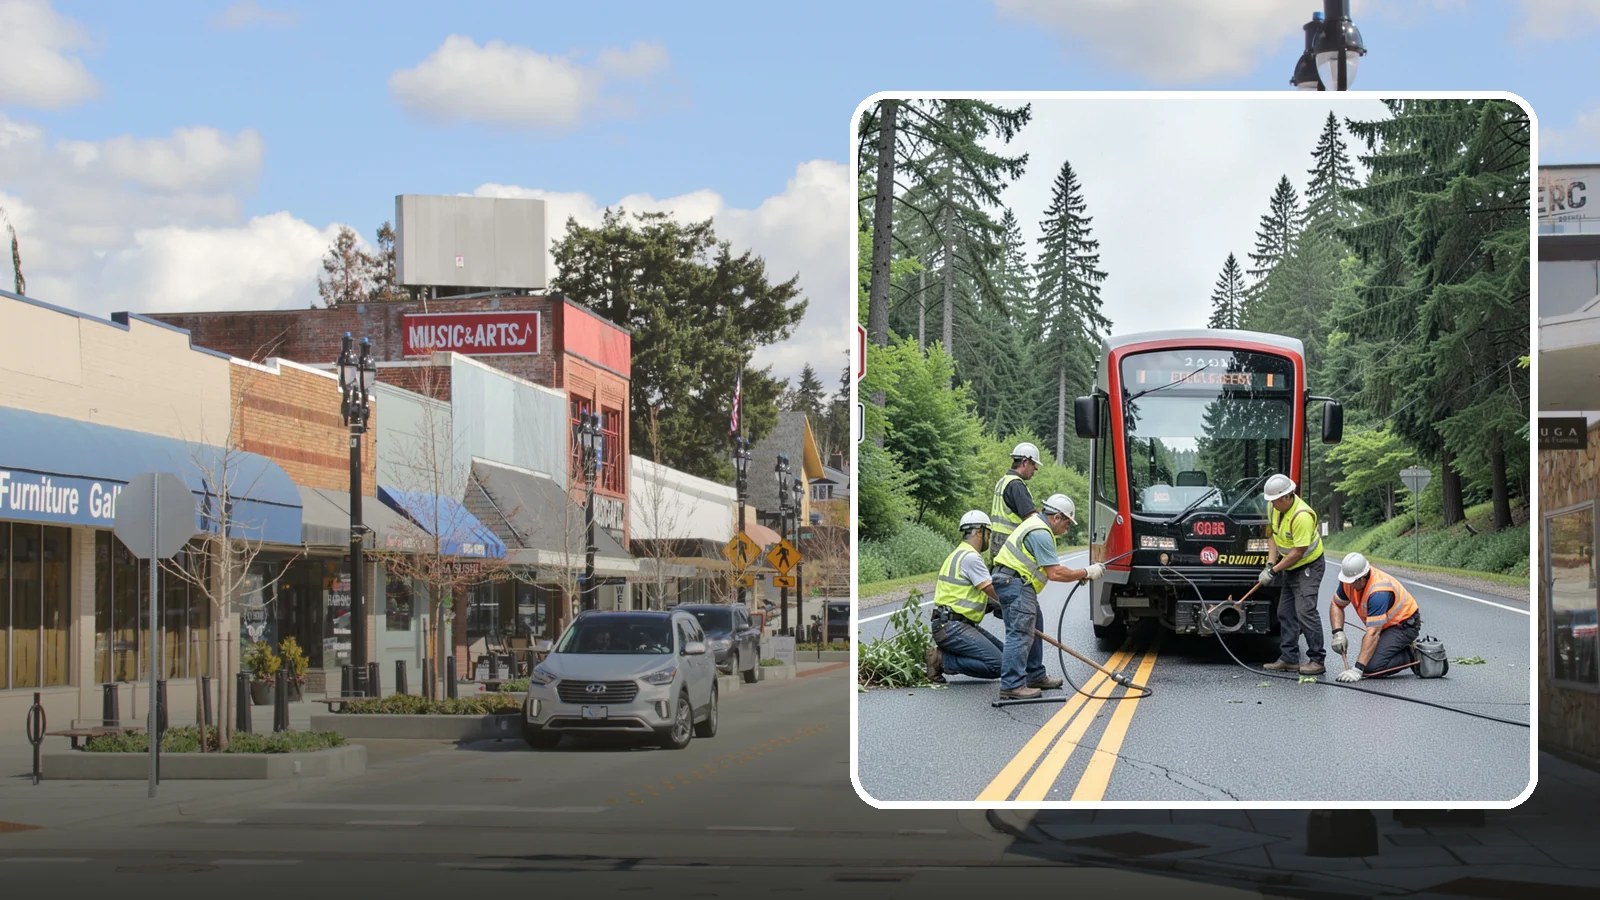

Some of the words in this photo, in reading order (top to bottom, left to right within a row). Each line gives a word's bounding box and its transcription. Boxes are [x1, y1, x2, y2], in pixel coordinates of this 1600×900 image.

[409, 322, 520, 349] MUSIC&ARTS
[0, 471, 79, 515] Furniture
[89, 482, 121, 519] Gal
[453, 563, 479, 574] SUSHI
